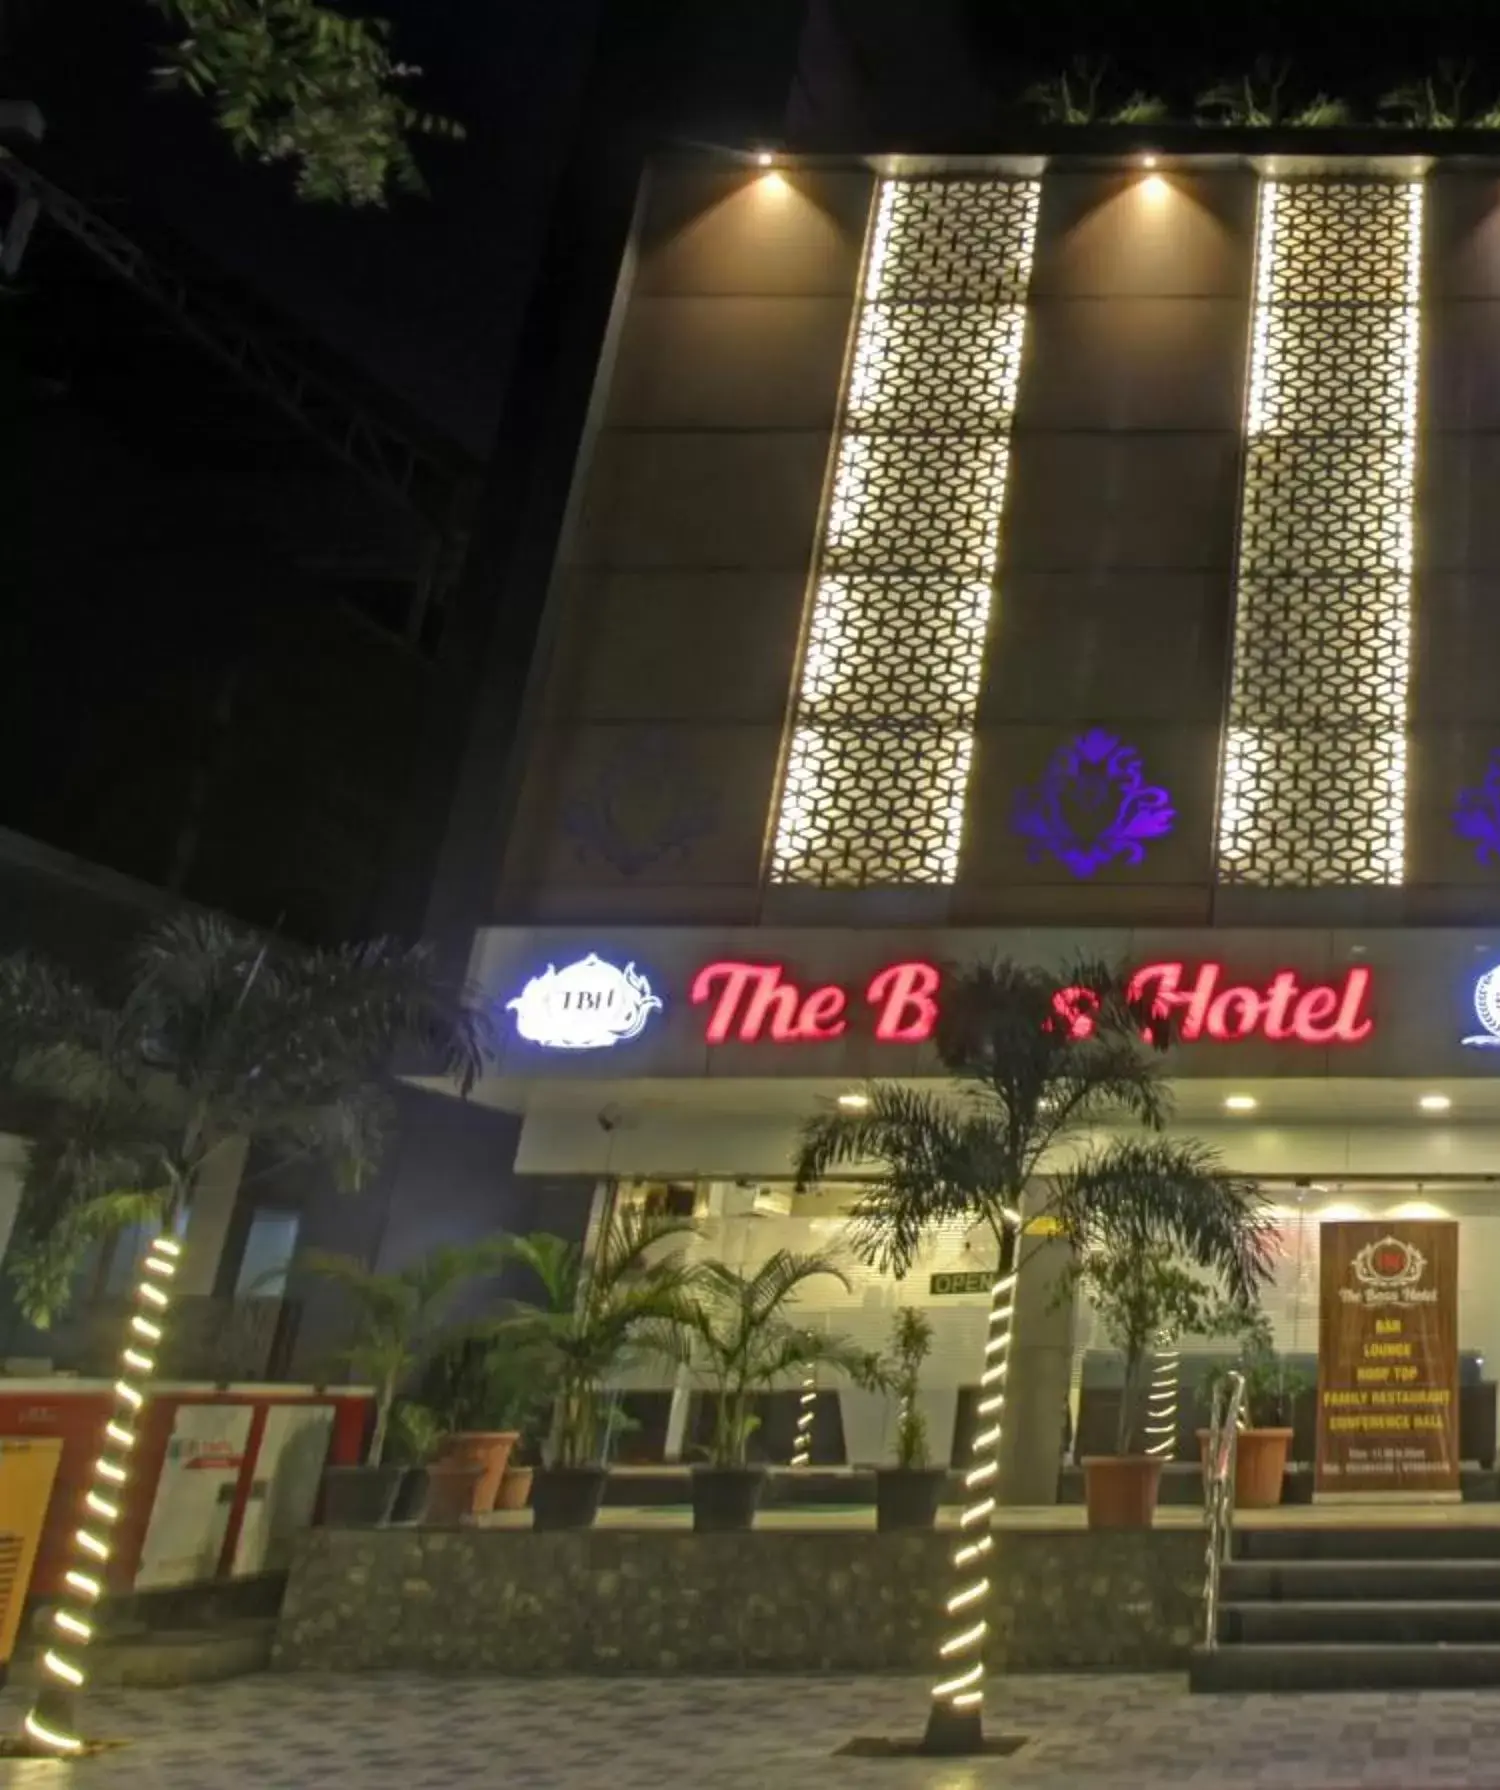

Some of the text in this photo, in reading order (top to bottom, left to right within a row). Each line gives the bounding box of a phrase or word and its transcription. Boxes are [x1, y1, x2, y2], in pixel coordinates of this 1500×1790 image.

[691, 961, 1373, 1044] The Bs Hotel
[935, 1273, 993, 1292] OPEN
[1375, 1319, 1402, 1334] BAR
[1364, 1343, 1412, 1358] LOUNGE
[1394, 1366, 1418, 1381] TOP
[1323, 1389, 1451, 1407] FAMILY RESTAURANT
[1329, 1414, 1444, 1431] CONFERENCE HALL
